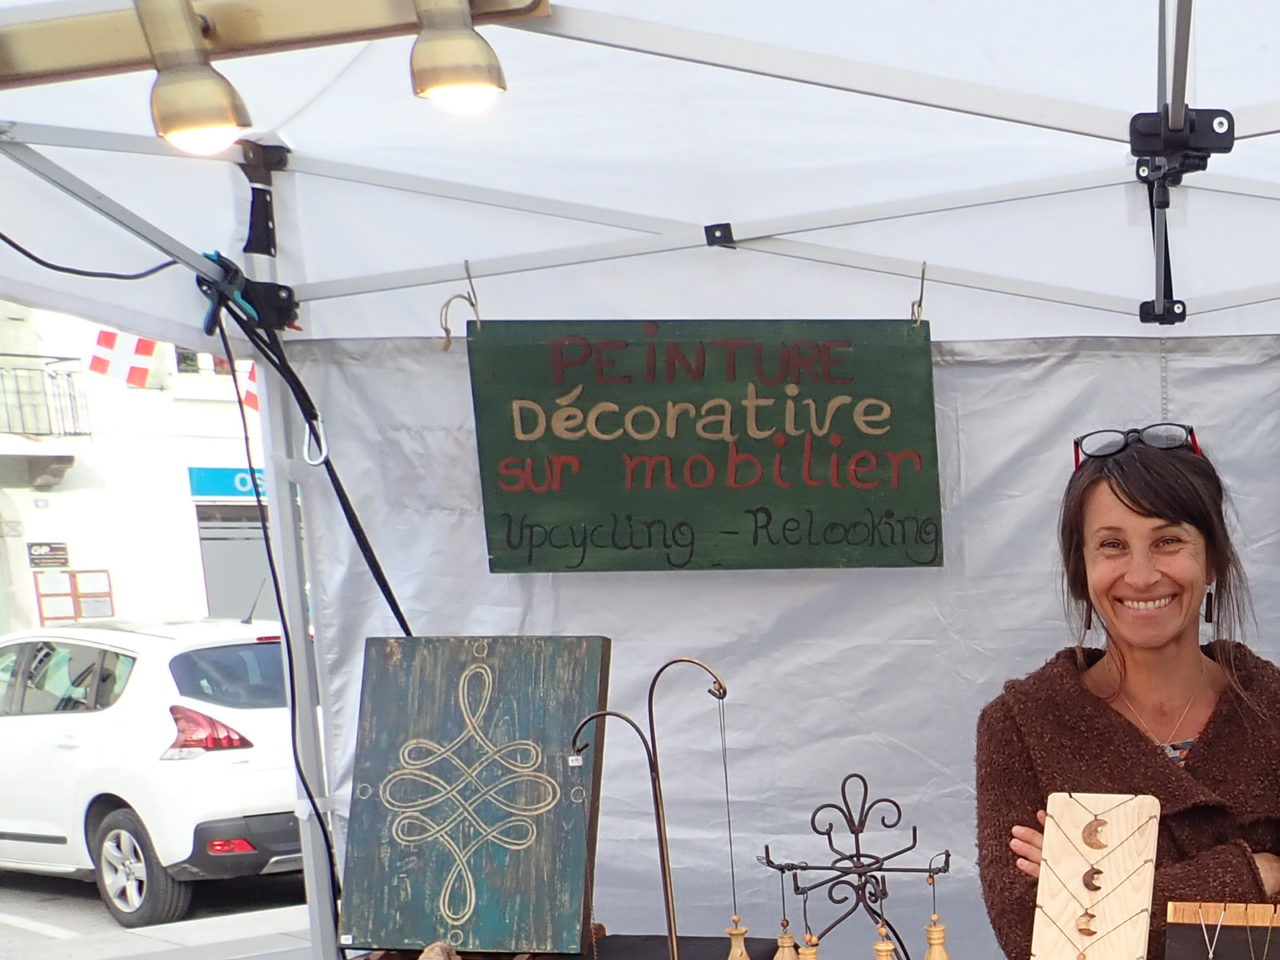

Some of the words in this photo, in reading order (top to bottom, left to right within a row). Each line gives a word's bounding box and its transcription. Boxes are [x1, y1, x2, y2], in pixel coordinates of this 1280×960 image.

[512, 382, 893, 441] Décorative
[498, 452, 580, 493] sur
[621, 433, 923, 491] mobilier
[502, 513, 695, 569] Upcycling
[744, 506, 941, 564] Relooking
